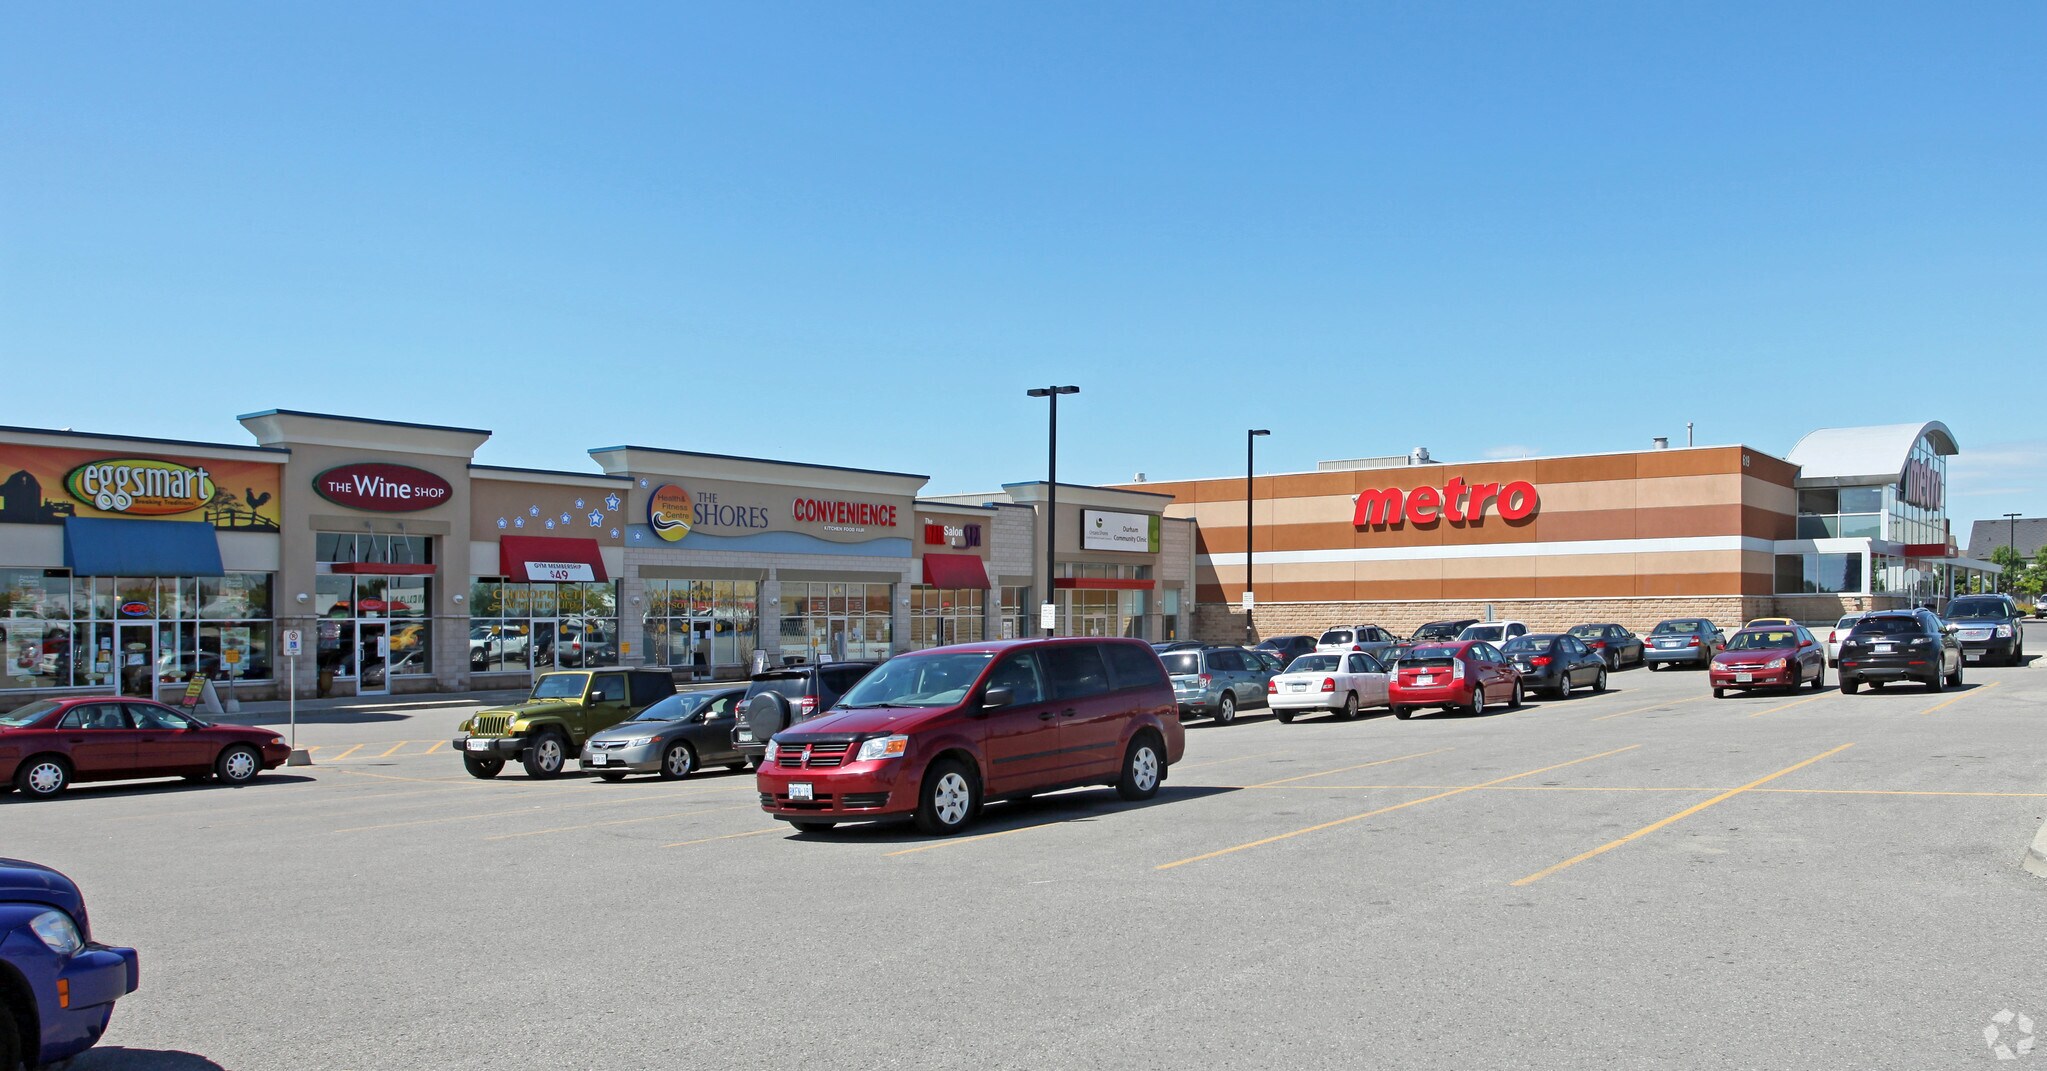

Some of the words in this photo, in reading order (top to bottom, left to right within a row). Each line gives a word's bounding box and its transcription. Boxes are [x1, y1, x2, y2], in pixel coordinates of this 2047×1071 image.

[83, 465, 209, 511] eggsmart
[328, 481, 352, 493] THE
[352, 474, 412, 499] Wine
[414, 487, 445, 498] SHOP
[697, 492, 718, 504] THE
[1352, 476, 1538, 526] metro
[662, 502, 688, 511] Fitness
[793, 498, 897, 527] CONVENIENCE
[665, 511, 690, 520] Centre
[693, 503, 769, 528] SHORES
[925, 517, 933, 525] The
[944, 525, 963, 537] Salon
[951, 537, 956, 546] &
[1113, 534, 1136, 543] Community
[549, 570, 569, 580] $49
